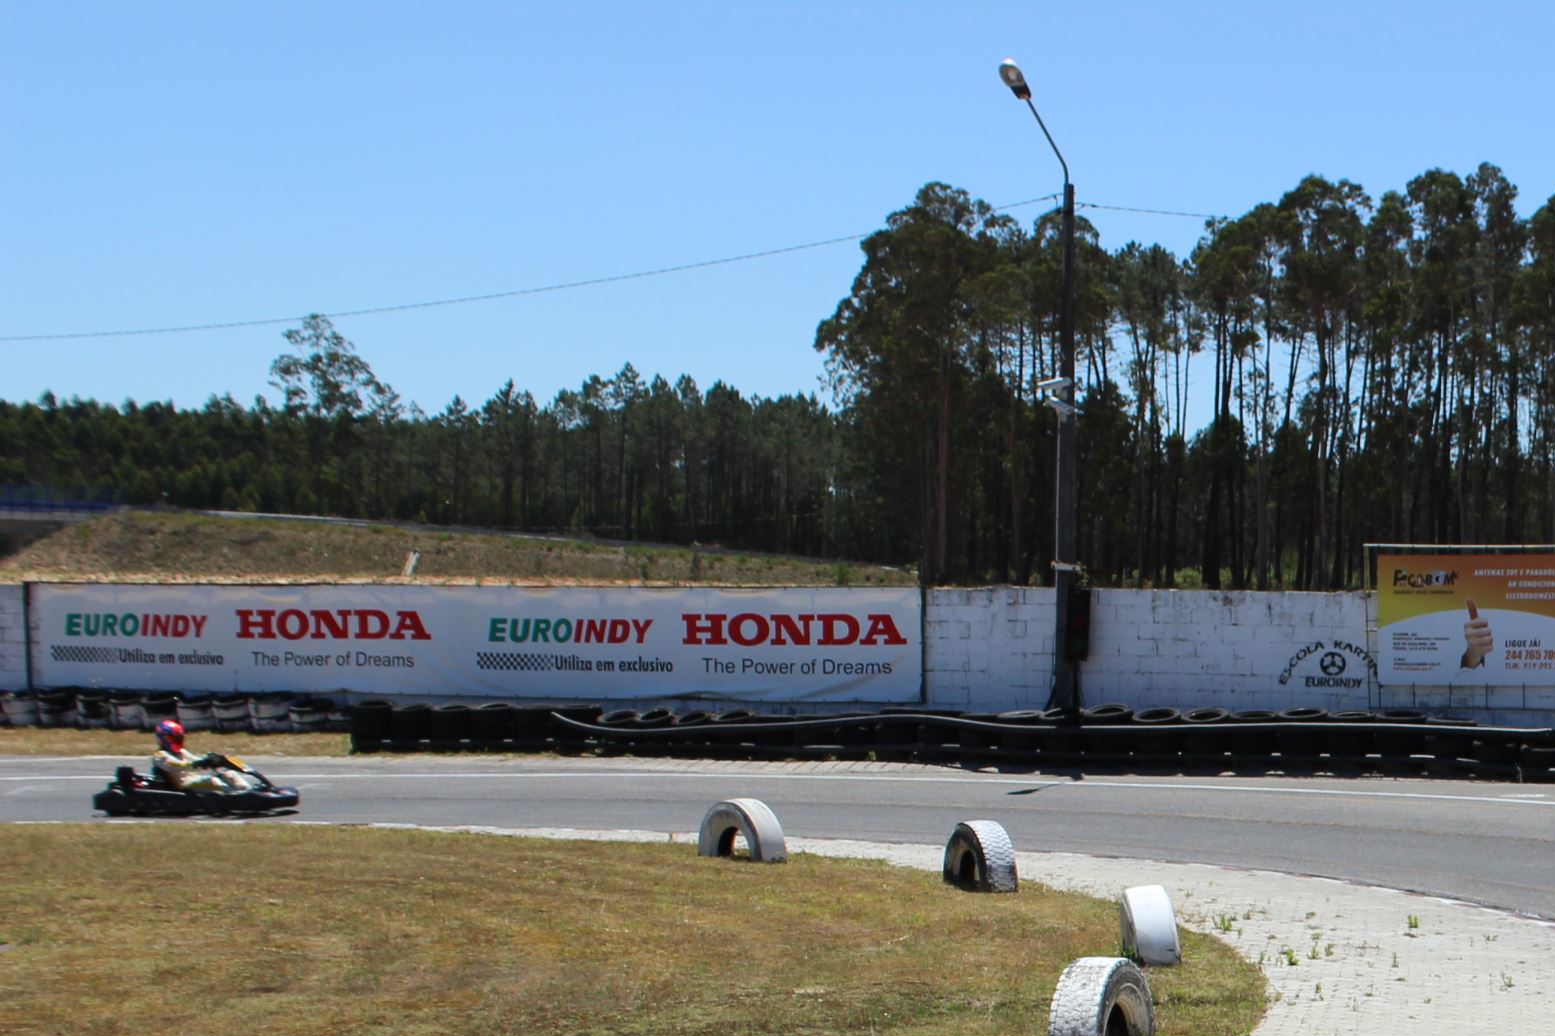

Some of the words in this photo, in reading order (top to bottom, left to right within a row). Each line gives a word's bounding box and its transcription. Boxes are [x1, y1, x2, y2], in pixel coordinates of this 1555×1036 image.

[64, 612, 207, 638] EUROINDY
[235, 609, 431, 641] HONDA
[488, 617, 653, 644] EUROINDY
[681, 613, 907, 646] HONDA
[118, 648, 156, 665] Utiliza
[158, 652, 176, 665] em
[178, 649, 224, 666] exclusivo
[252, 651, 279, 667] The
[283, 652, 333, 667] Power
[336, 652, 352, 667] of
[355, 652, 415, 668] Dreams
[554, 654, 592, 672] Utiliza
[596, 659, 616, 673] em
[619, 656, 674, 674] exclusivo
[1278, 640, 1325, 686] ESCOLA
[702, 658, 737, 674] The
[742, 658, 795, 675] Power
[800, 658, 817, 675] of
[821, 659, 892, 676] Dreams
[1305, 676, 1362, 689] EUROINDY
